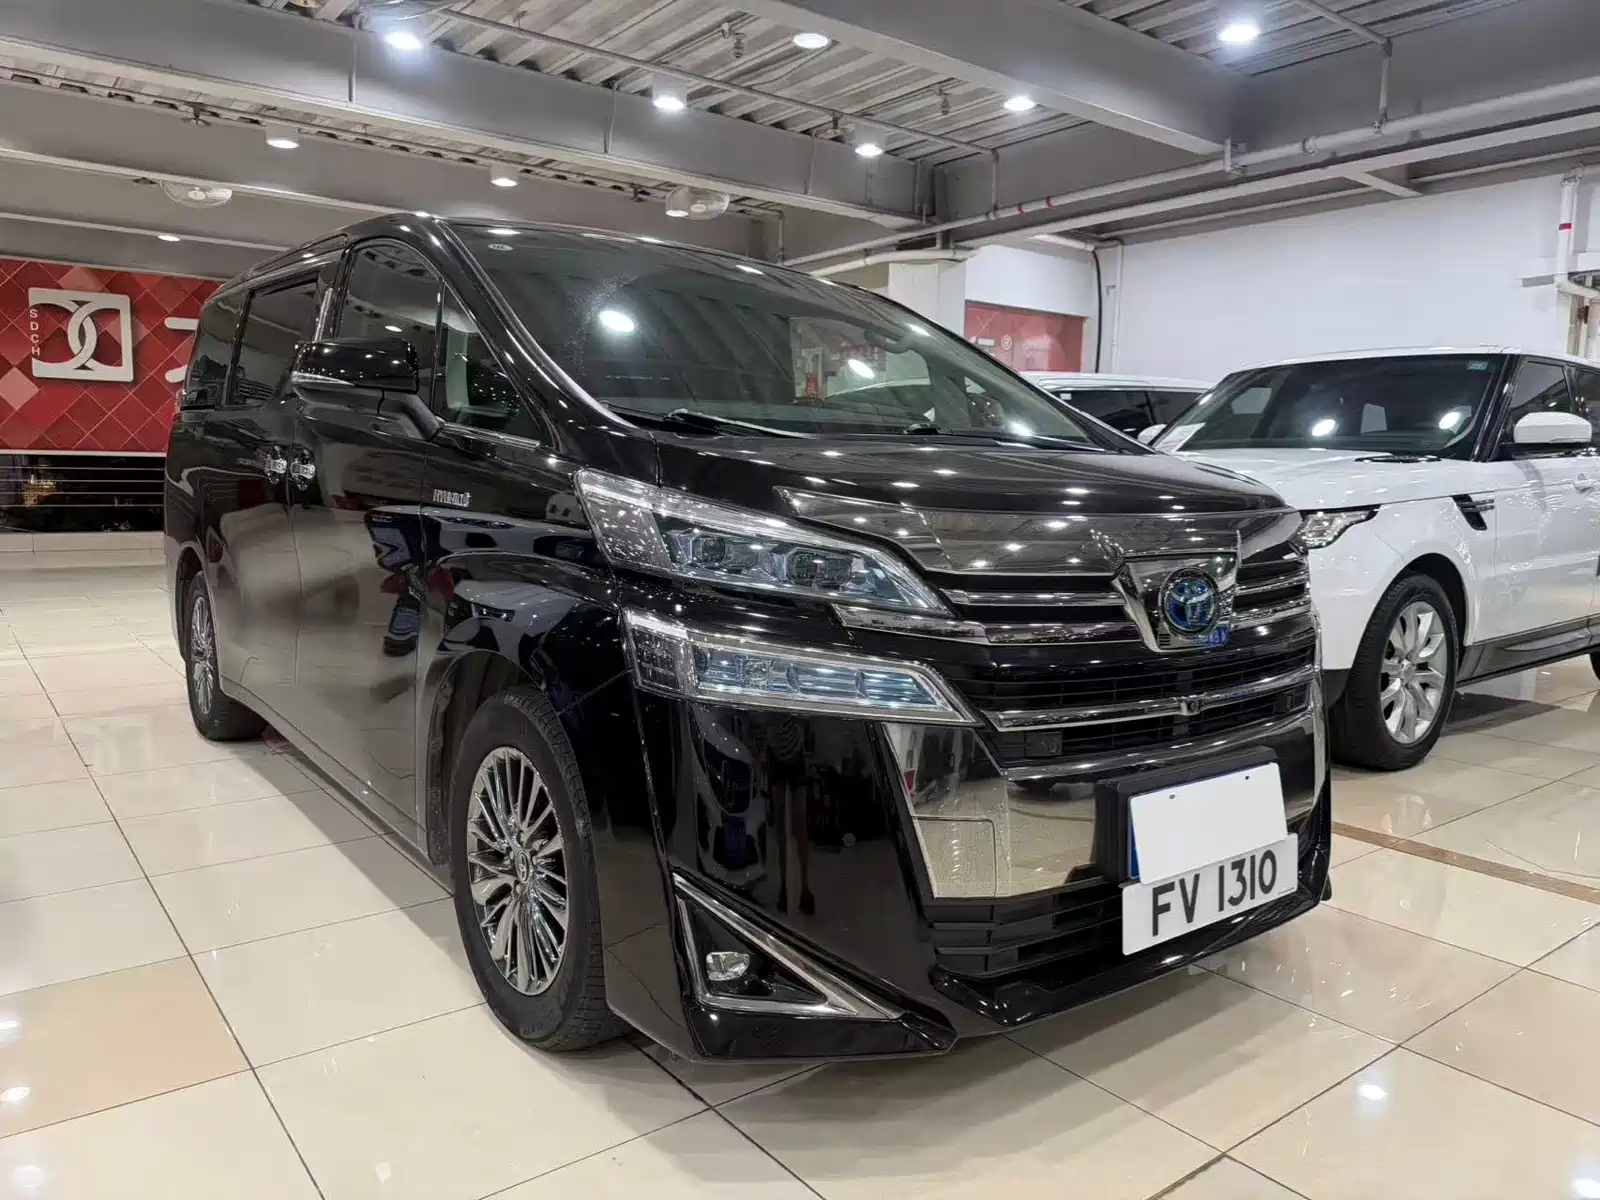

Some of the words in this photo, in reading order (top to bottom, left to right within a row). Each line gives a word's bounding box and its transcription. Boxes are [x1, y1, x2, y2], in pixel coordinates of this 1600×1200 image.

[29, 308, 41, 357] SDCH
[1151, 872, 1200, 937] FV
[1217, 849, 1278, 912] 1310
